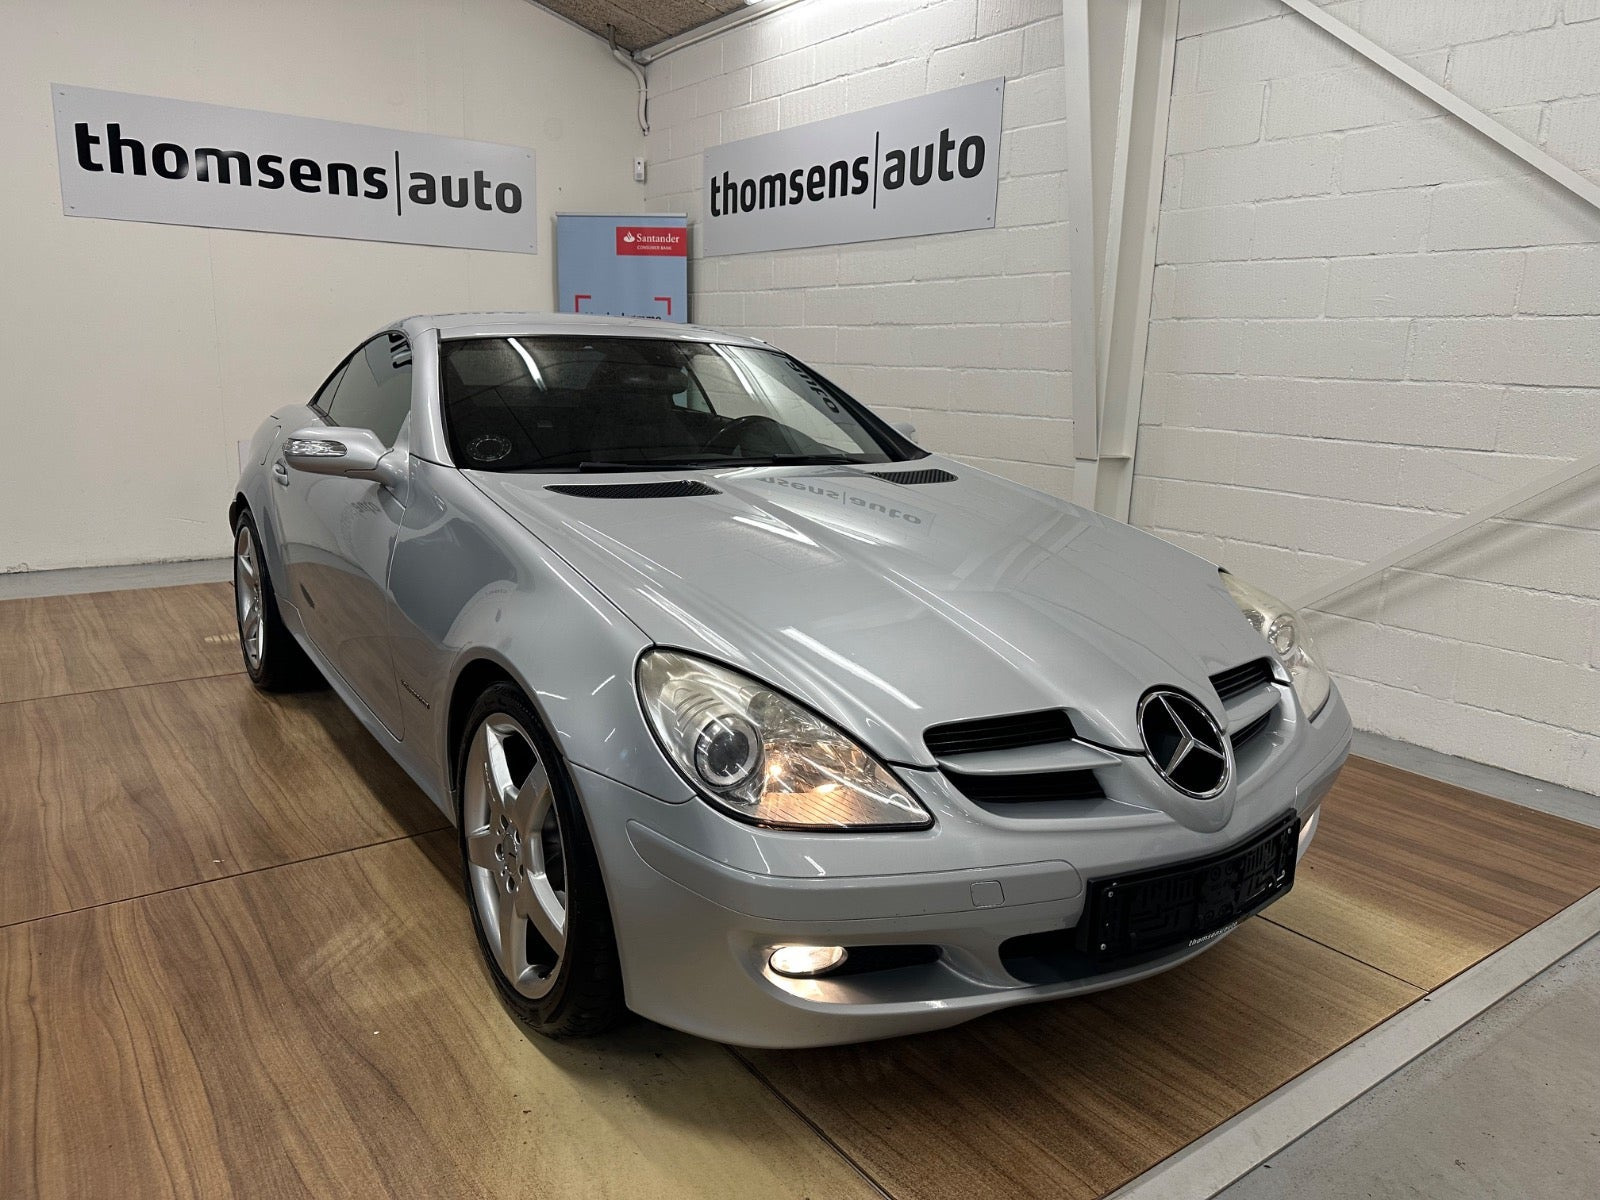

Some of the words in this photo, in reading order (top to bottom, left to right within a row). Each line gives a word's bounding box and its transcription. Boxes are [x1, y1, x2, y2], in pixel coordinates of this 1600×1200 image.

[74, 122, 389, 200] thomsens
[408, 170, 522, 214] auto
[710, 156, 869, 217] thomsens
[883, 128, 985, 190] auto
[636, 233, 680, 243] Santander
